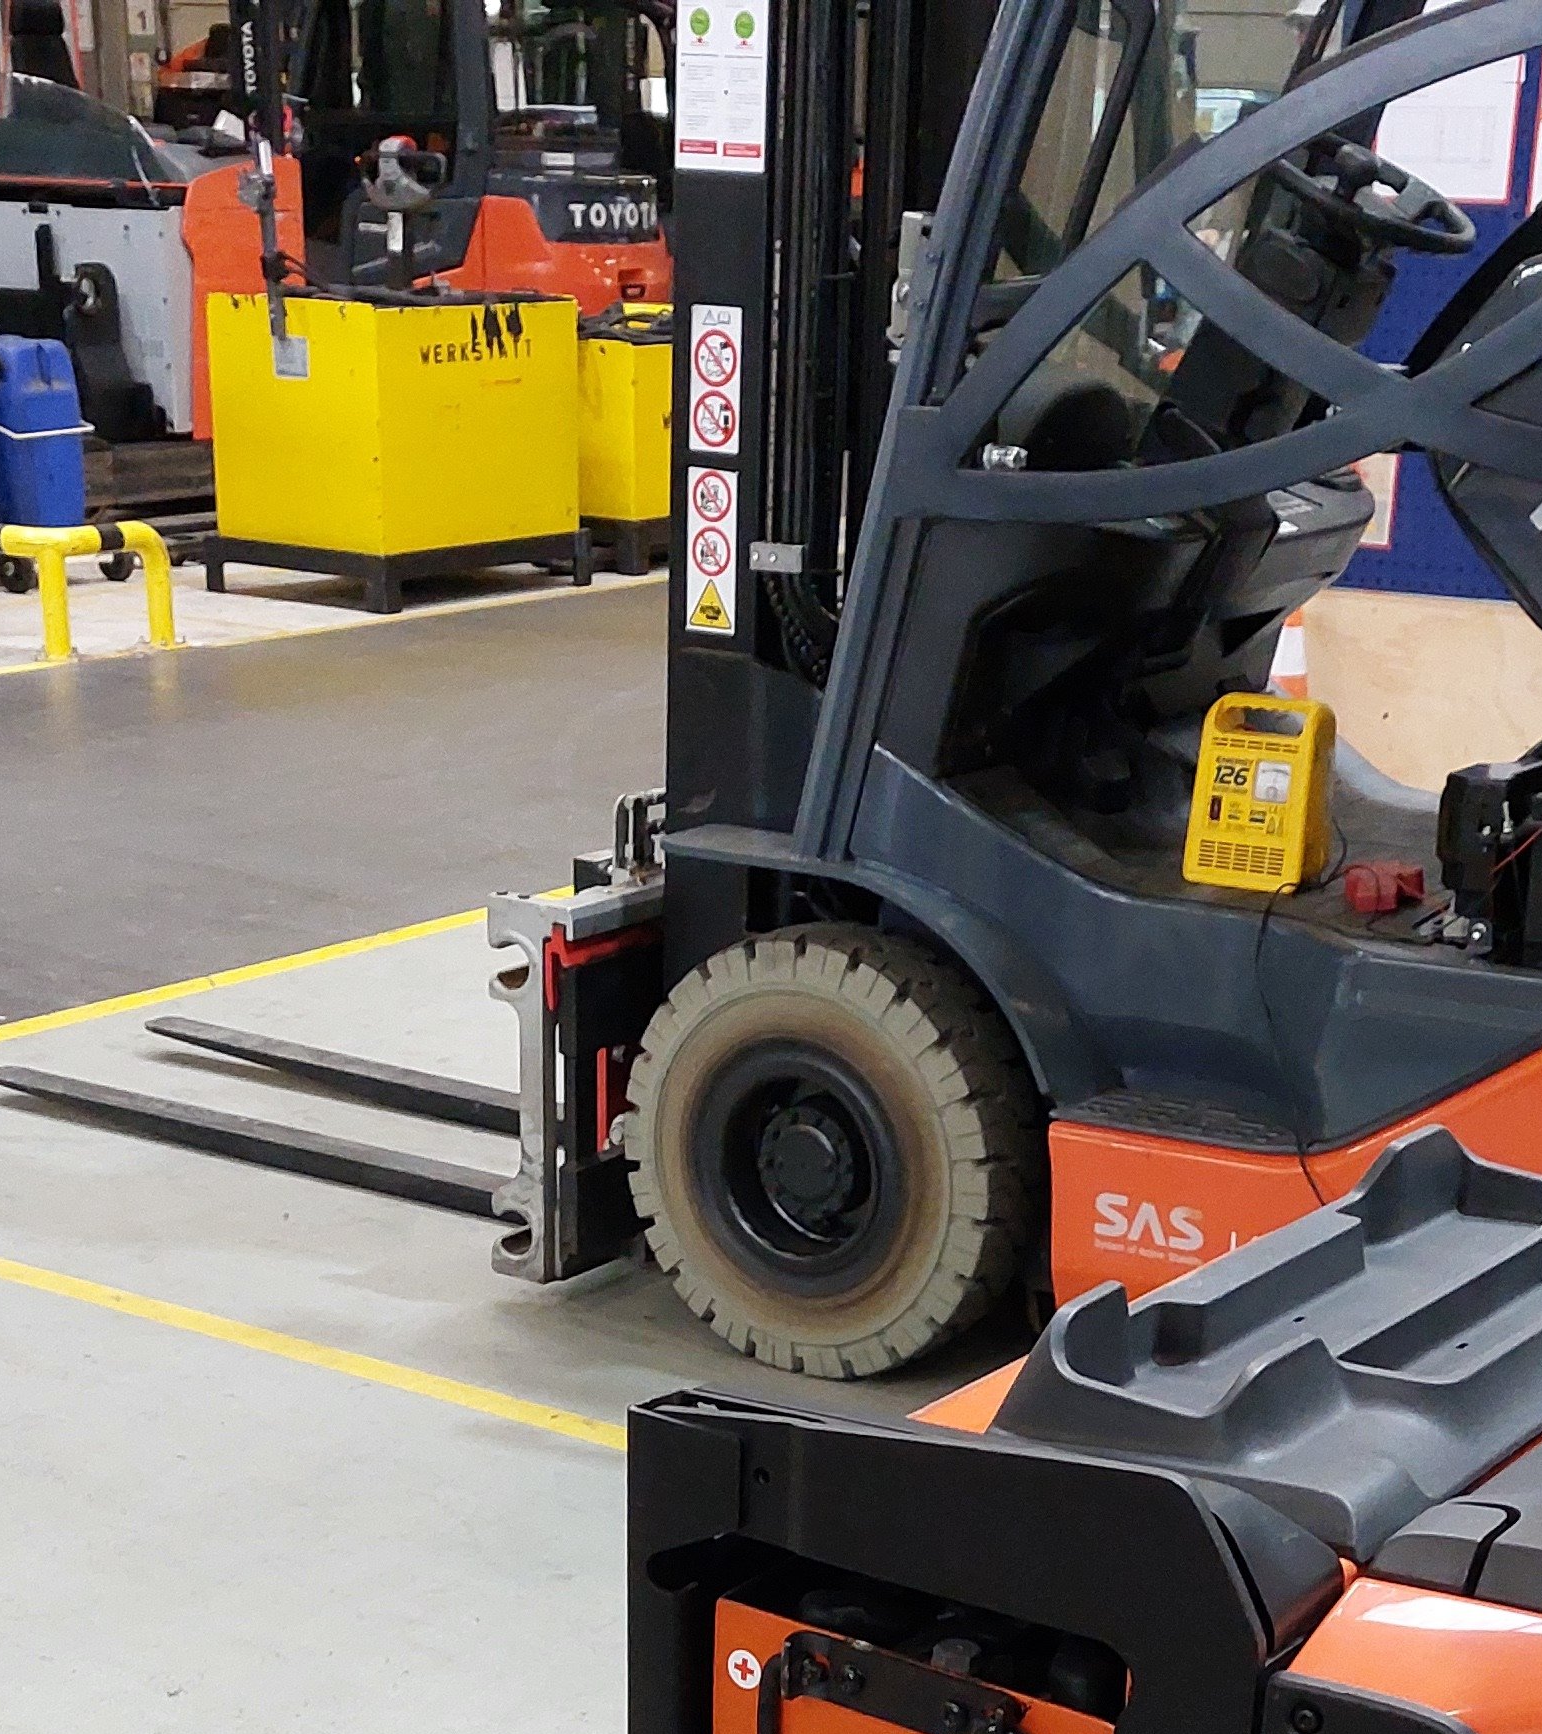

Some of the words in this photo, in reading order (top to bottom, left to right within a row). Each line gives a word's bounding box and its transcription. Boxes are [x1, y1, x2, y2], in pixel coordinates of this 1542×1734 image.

[240, 21, 257, 95] TOYOTA
[1213, 765, 1251, 786] 126
[1093, 1192, 1205, 1250] SAS
